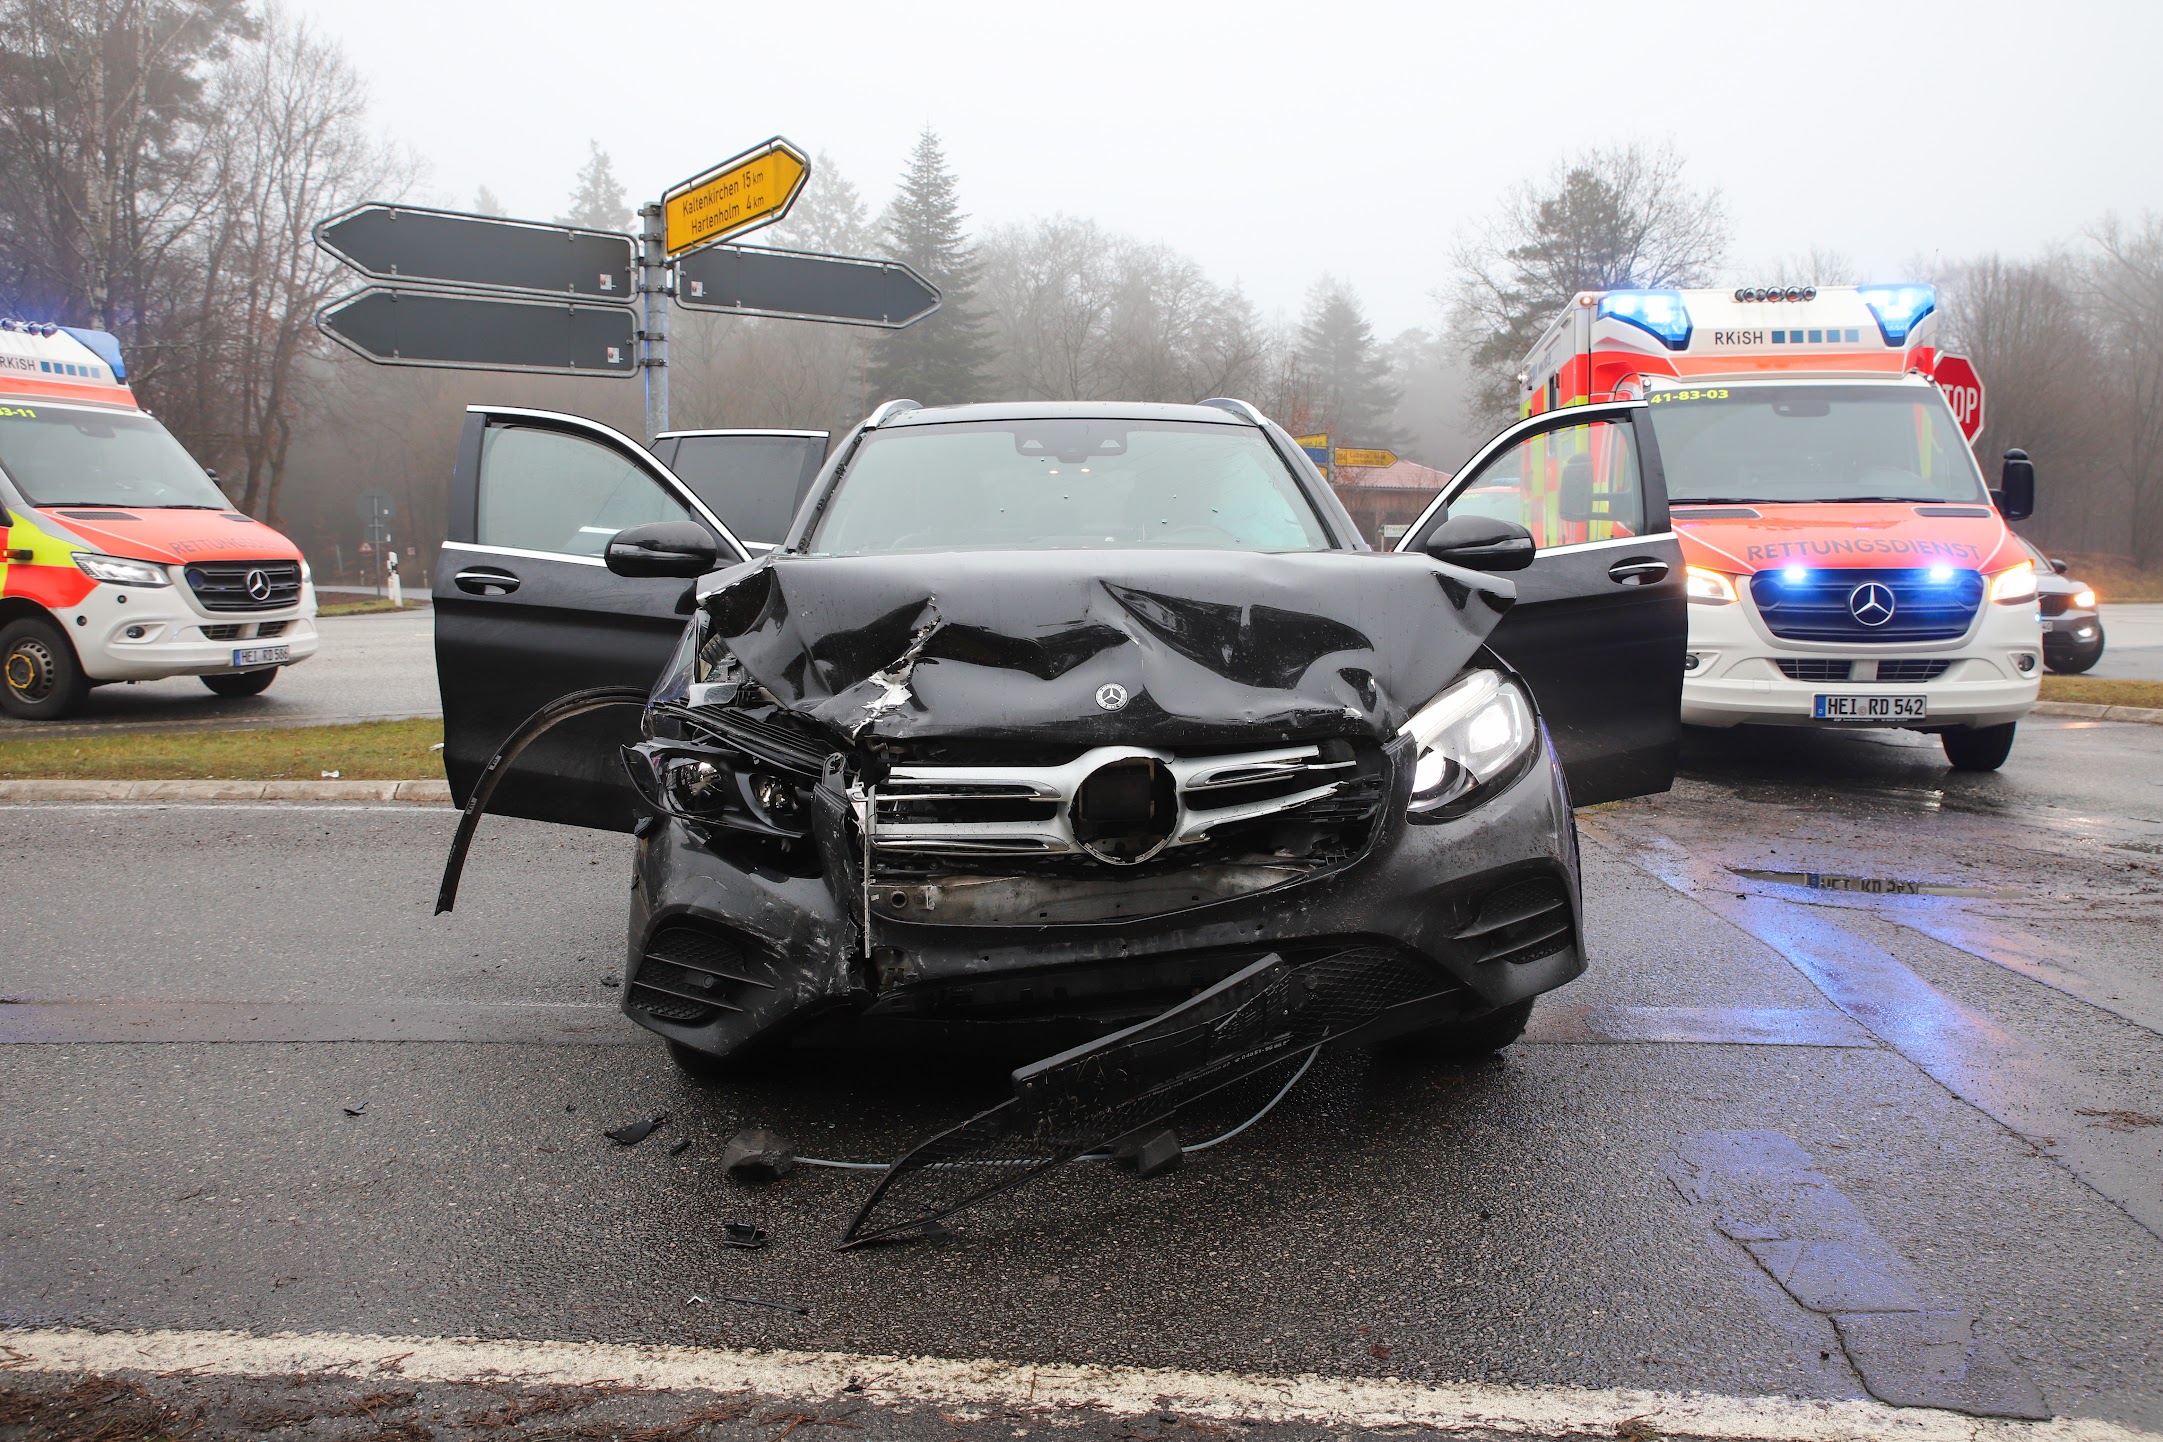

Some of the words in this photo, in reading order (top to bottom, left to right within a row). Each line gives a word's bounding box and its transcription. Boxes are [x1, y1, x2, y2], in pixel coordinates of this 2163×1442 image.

[682, 181, 739, 217] Kaltenkirchen
[742, 171, 751, 190] 15
[752, 172, 764, 185] km
[691, 203, 740, 235] Hartenholm
[746, 194, 752, 211] 4
[753, 196, 765, 209] km
[1714, 330, 1764, 345] RKiSH
[1650, 389, 1730, 405] 41-83-03
[1941, 384, 1979, 425] TOP
[1746, 538, 1981, 562] RETTUNGSDIENST
[241, 650, 258, 663] HEI
[262, 649, 274, 662] RD
[1827, 698, 1857, 716] HEI
[1868, 698, 1889, 716] RD
[1894, 698, 1924, 716] 542
